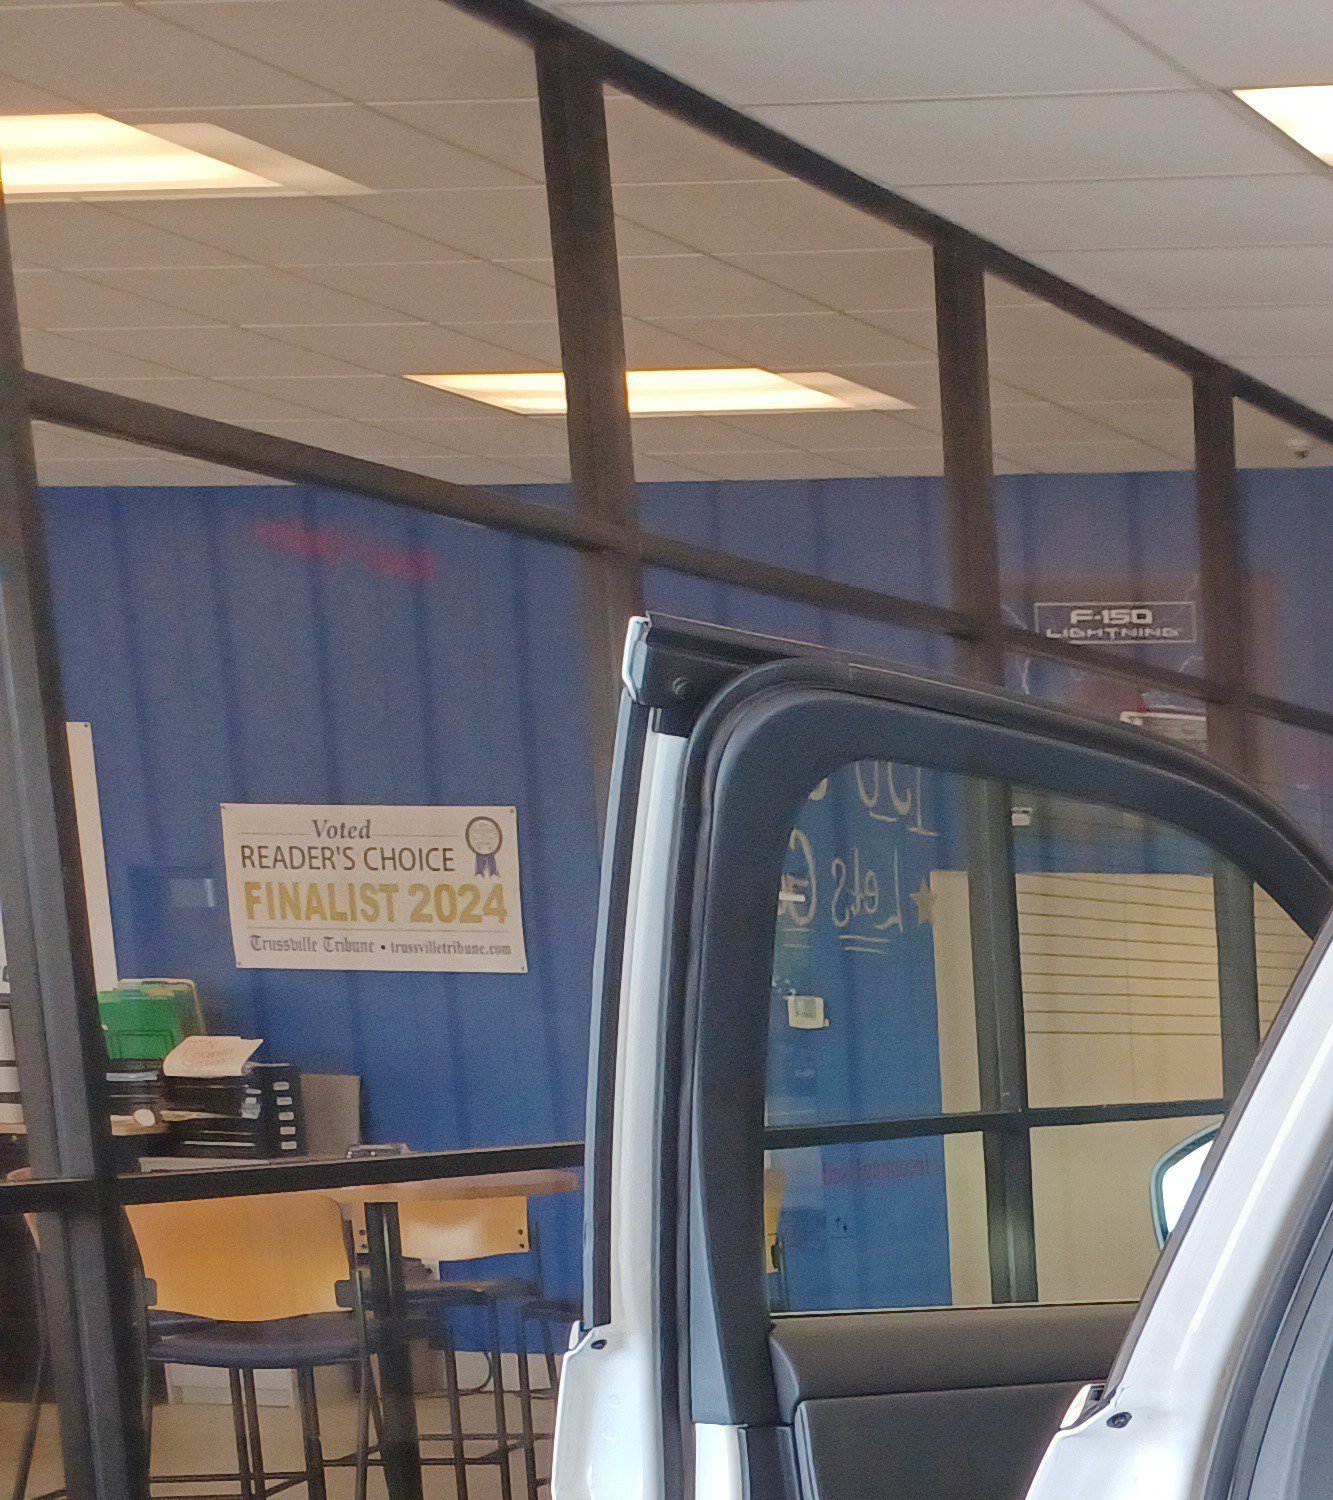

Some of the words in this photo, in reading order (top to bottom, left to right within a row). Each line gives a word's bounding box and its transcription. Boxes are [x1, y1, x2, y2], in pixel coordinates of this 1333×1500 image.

[1069, 608, 1153, 625] F-150
[1045, 626, 1180, 640] LIGHTNING
[312, 818, 371, 839] Voted
[240, 844, 356, 871] READER'S
[363, 846, 455, 872] CHOICE
[244, 881, 400, 923] FINALIST
[408, 882, 508, 924] 2024
[250, 934, 317, 952] Trussville
[322, 936, 375, 954] Tribune
[390, 940, 512, 955] trussvilletribune.com
